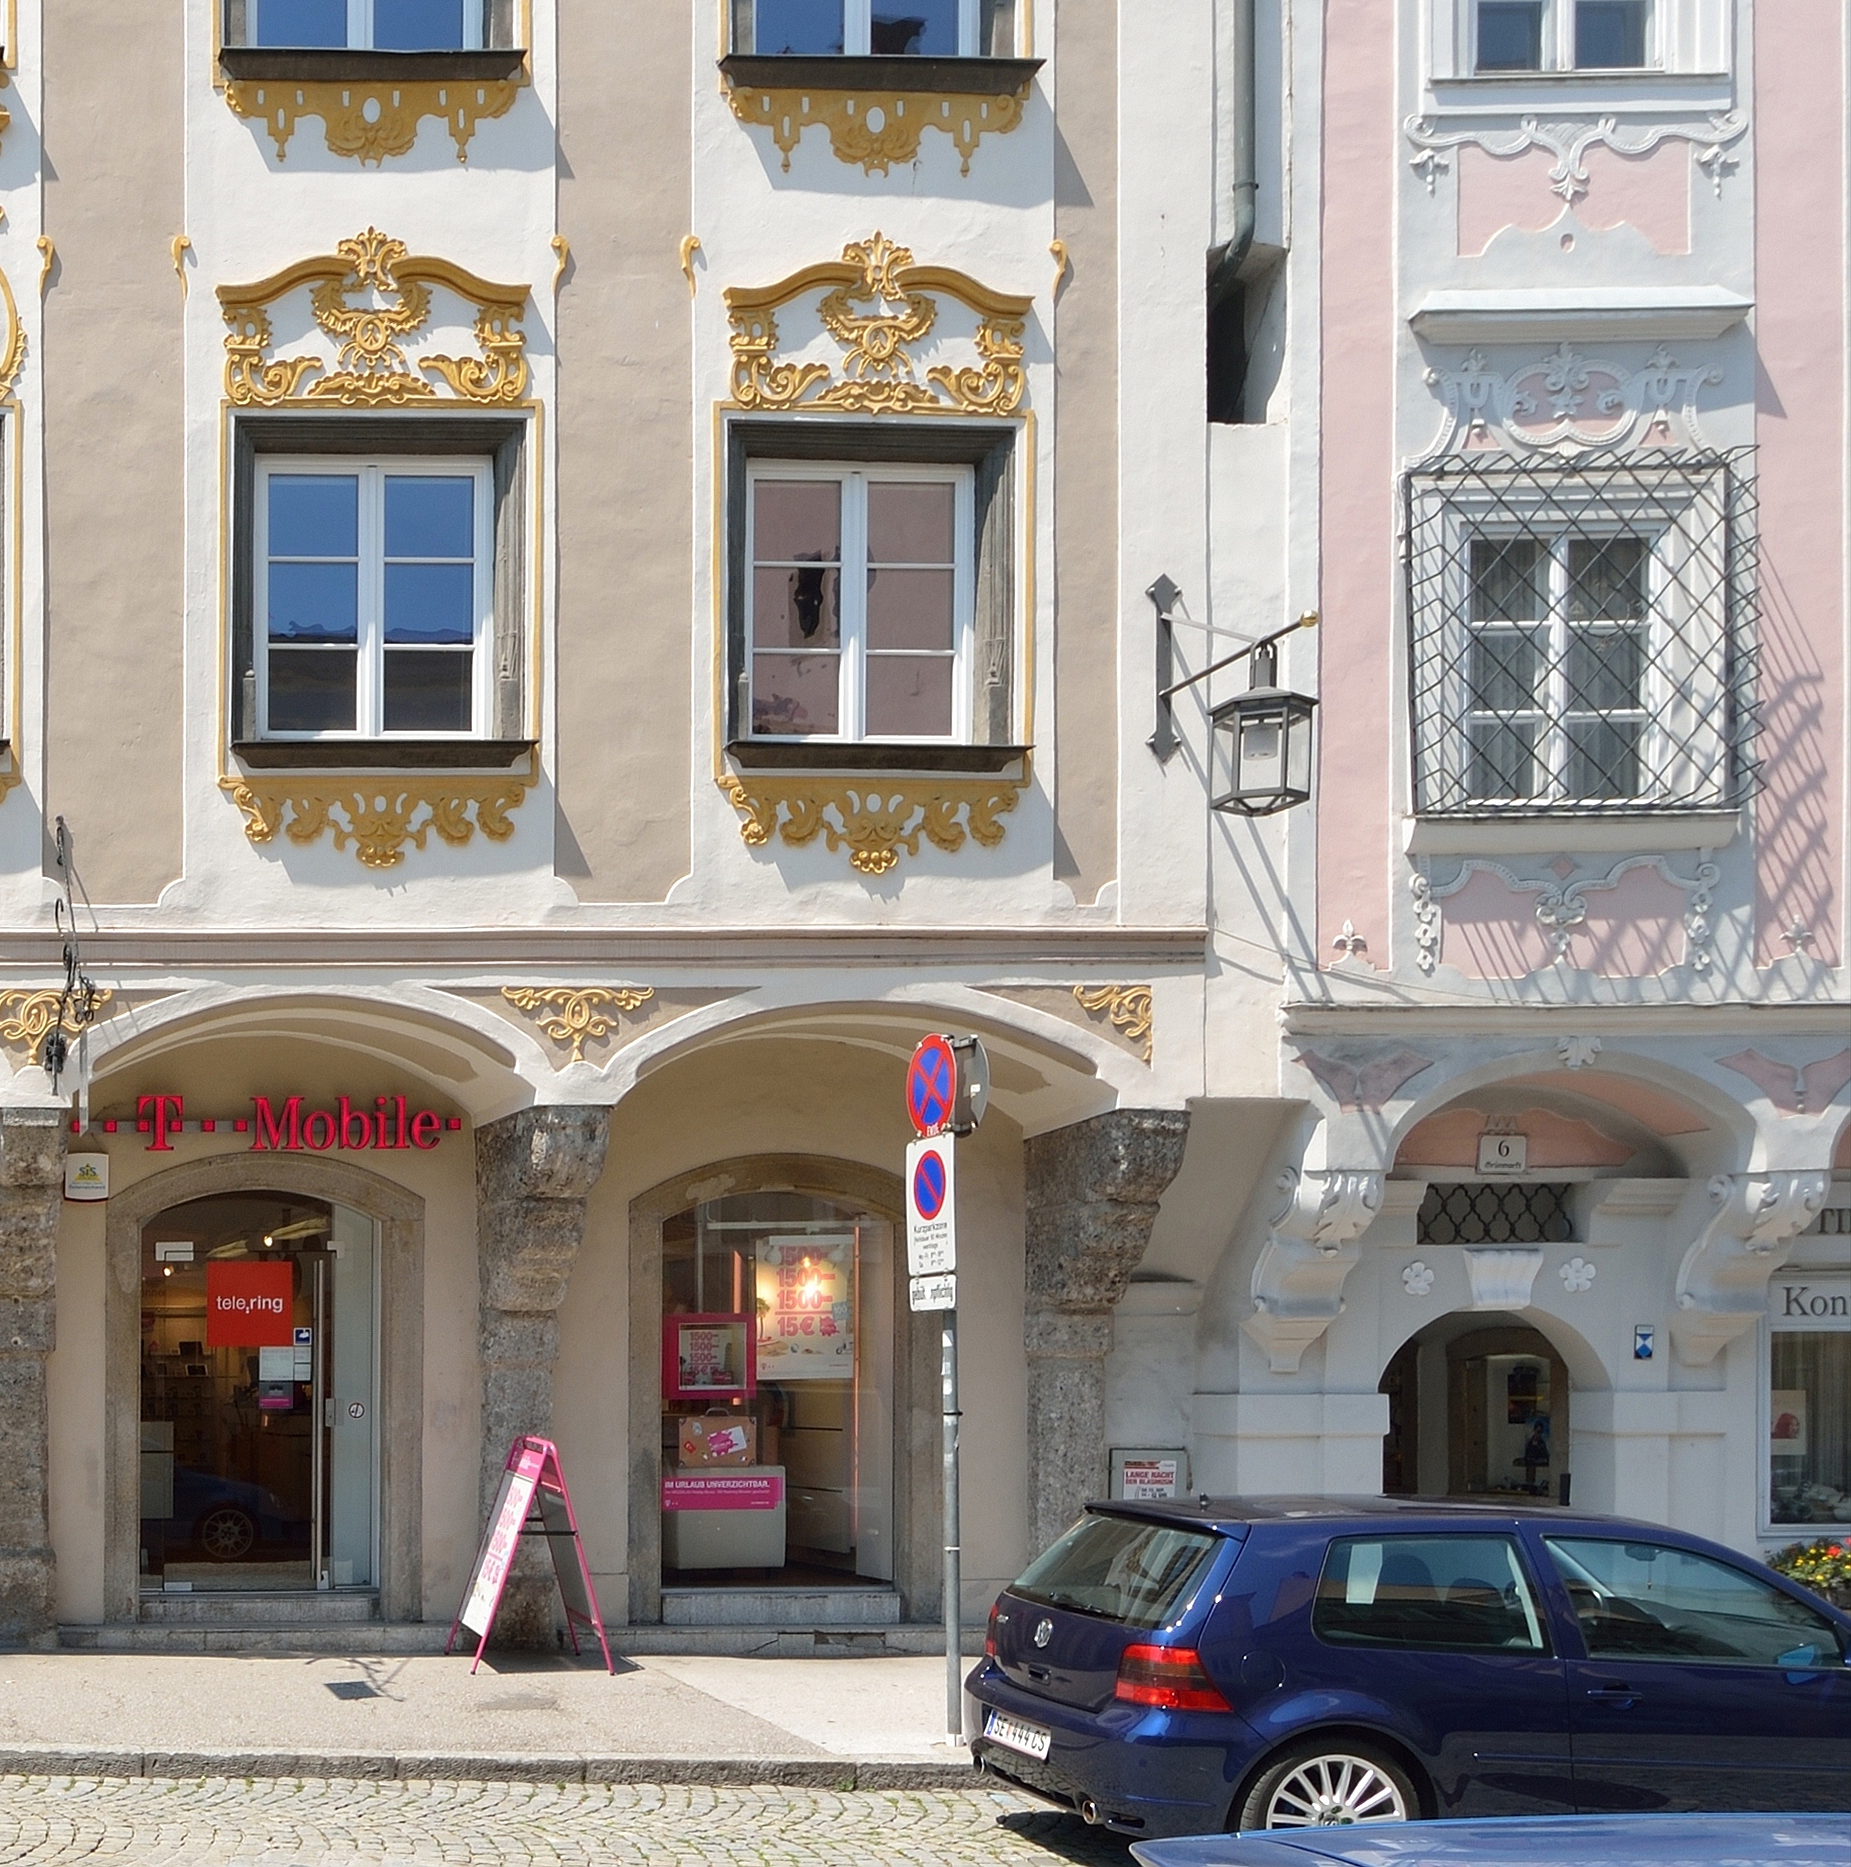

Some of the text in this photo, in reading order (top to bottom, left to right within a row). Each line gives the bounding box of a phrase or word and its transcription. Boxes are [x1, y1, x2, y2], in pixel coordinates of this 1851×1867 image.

[249, 1095, 441, 1151] Mobile
[1498, 1140, 1510, 1158] 6
[1782, 1286, 1851, 1316] Kon
[994, 1715, 1008, 1737] SE
